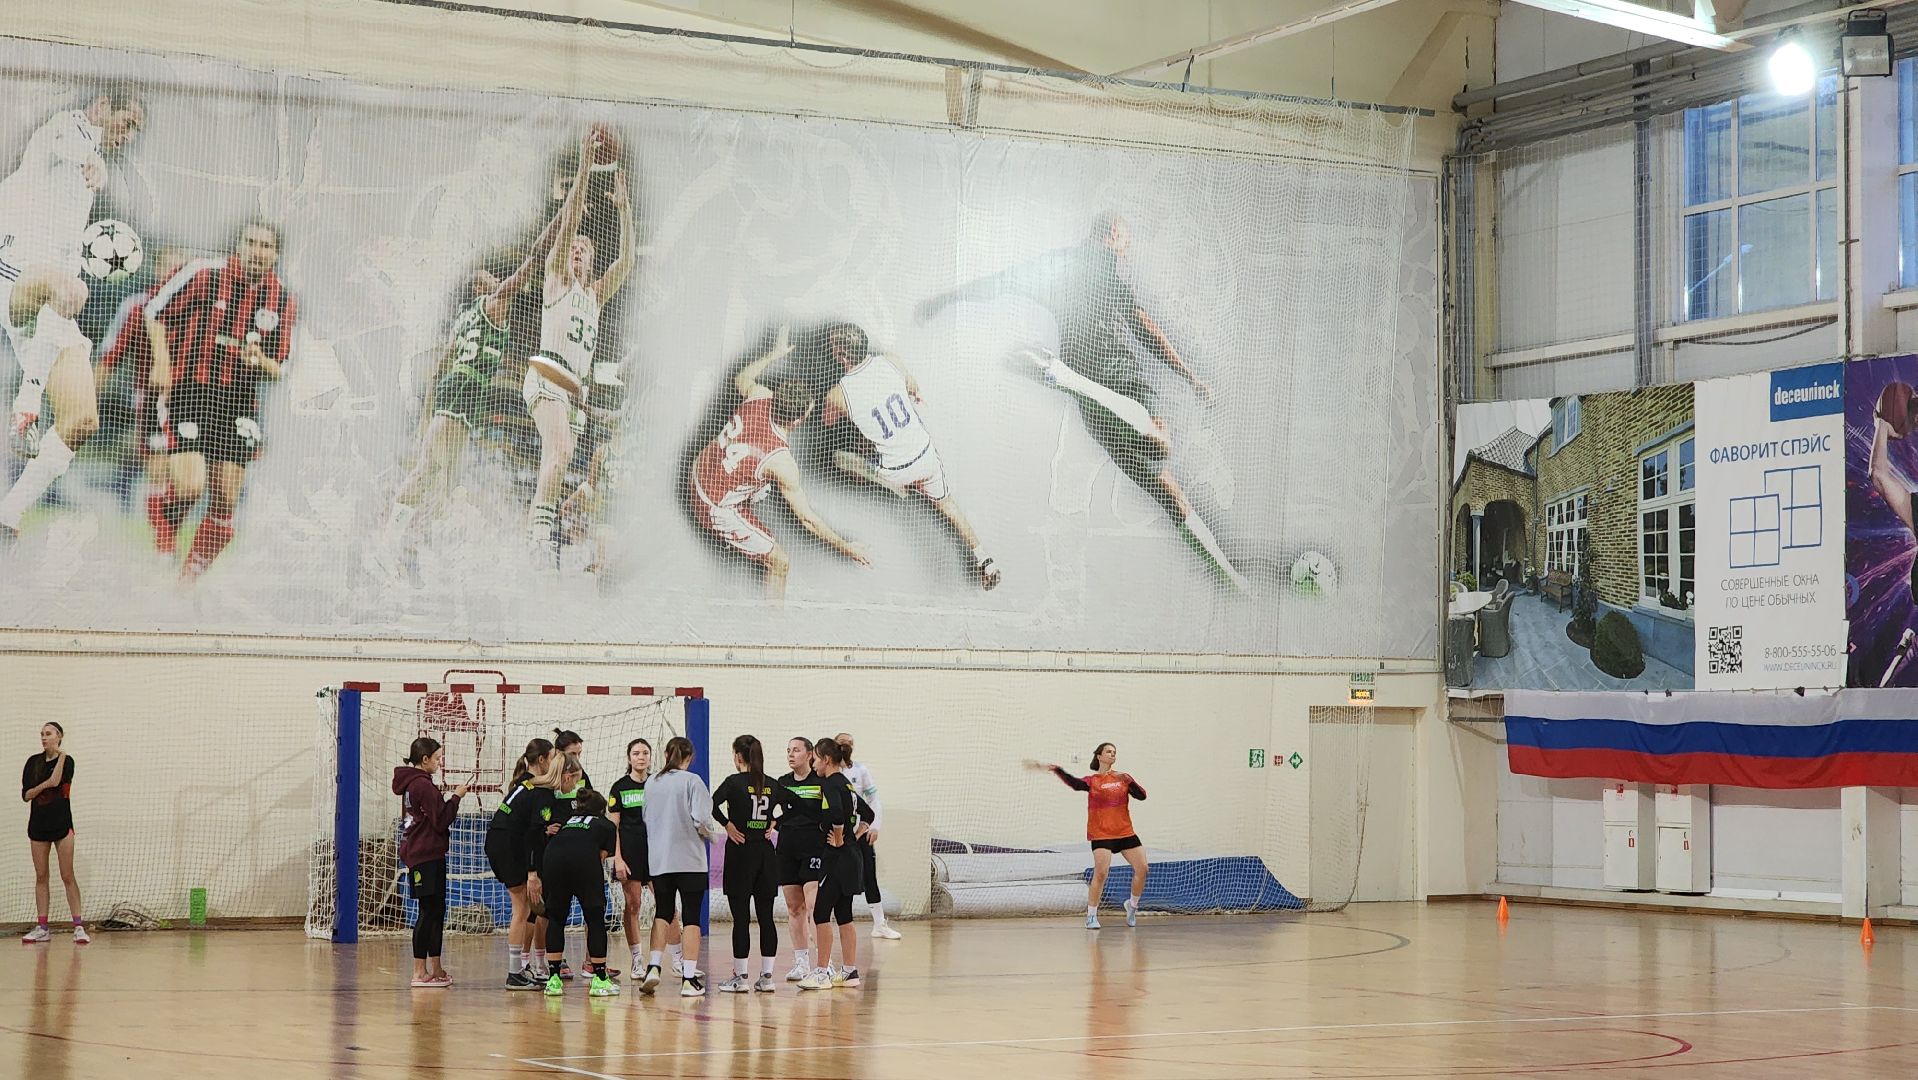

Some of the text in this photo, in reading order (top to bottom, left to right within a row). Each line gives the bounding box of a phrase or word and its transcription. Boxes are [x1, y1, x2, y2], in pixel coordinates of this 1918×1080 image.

[566, 315, 596, 353] 33
[1774, 380, 1840, 405] deceuninck
[871, 393, 910, 439] 10
[717, 414, 750, 475] 24
[1710, 433, 1831, 464] ФАВОРИТ СПЭЙС
[1720, 574, 1820, 591] СОВЕРШЕННЫЕ ОКНА
[1725, 592, 1816, 608] ПО ЦЕНЕ ОБЫЧНЫХ
[1764, 644, 1837, 658] 8-800-555-55-06
[622, 793, 645, 805] LEMON
[750, 794, 770, 820] 12
[810, 857, 822, 869] 23
